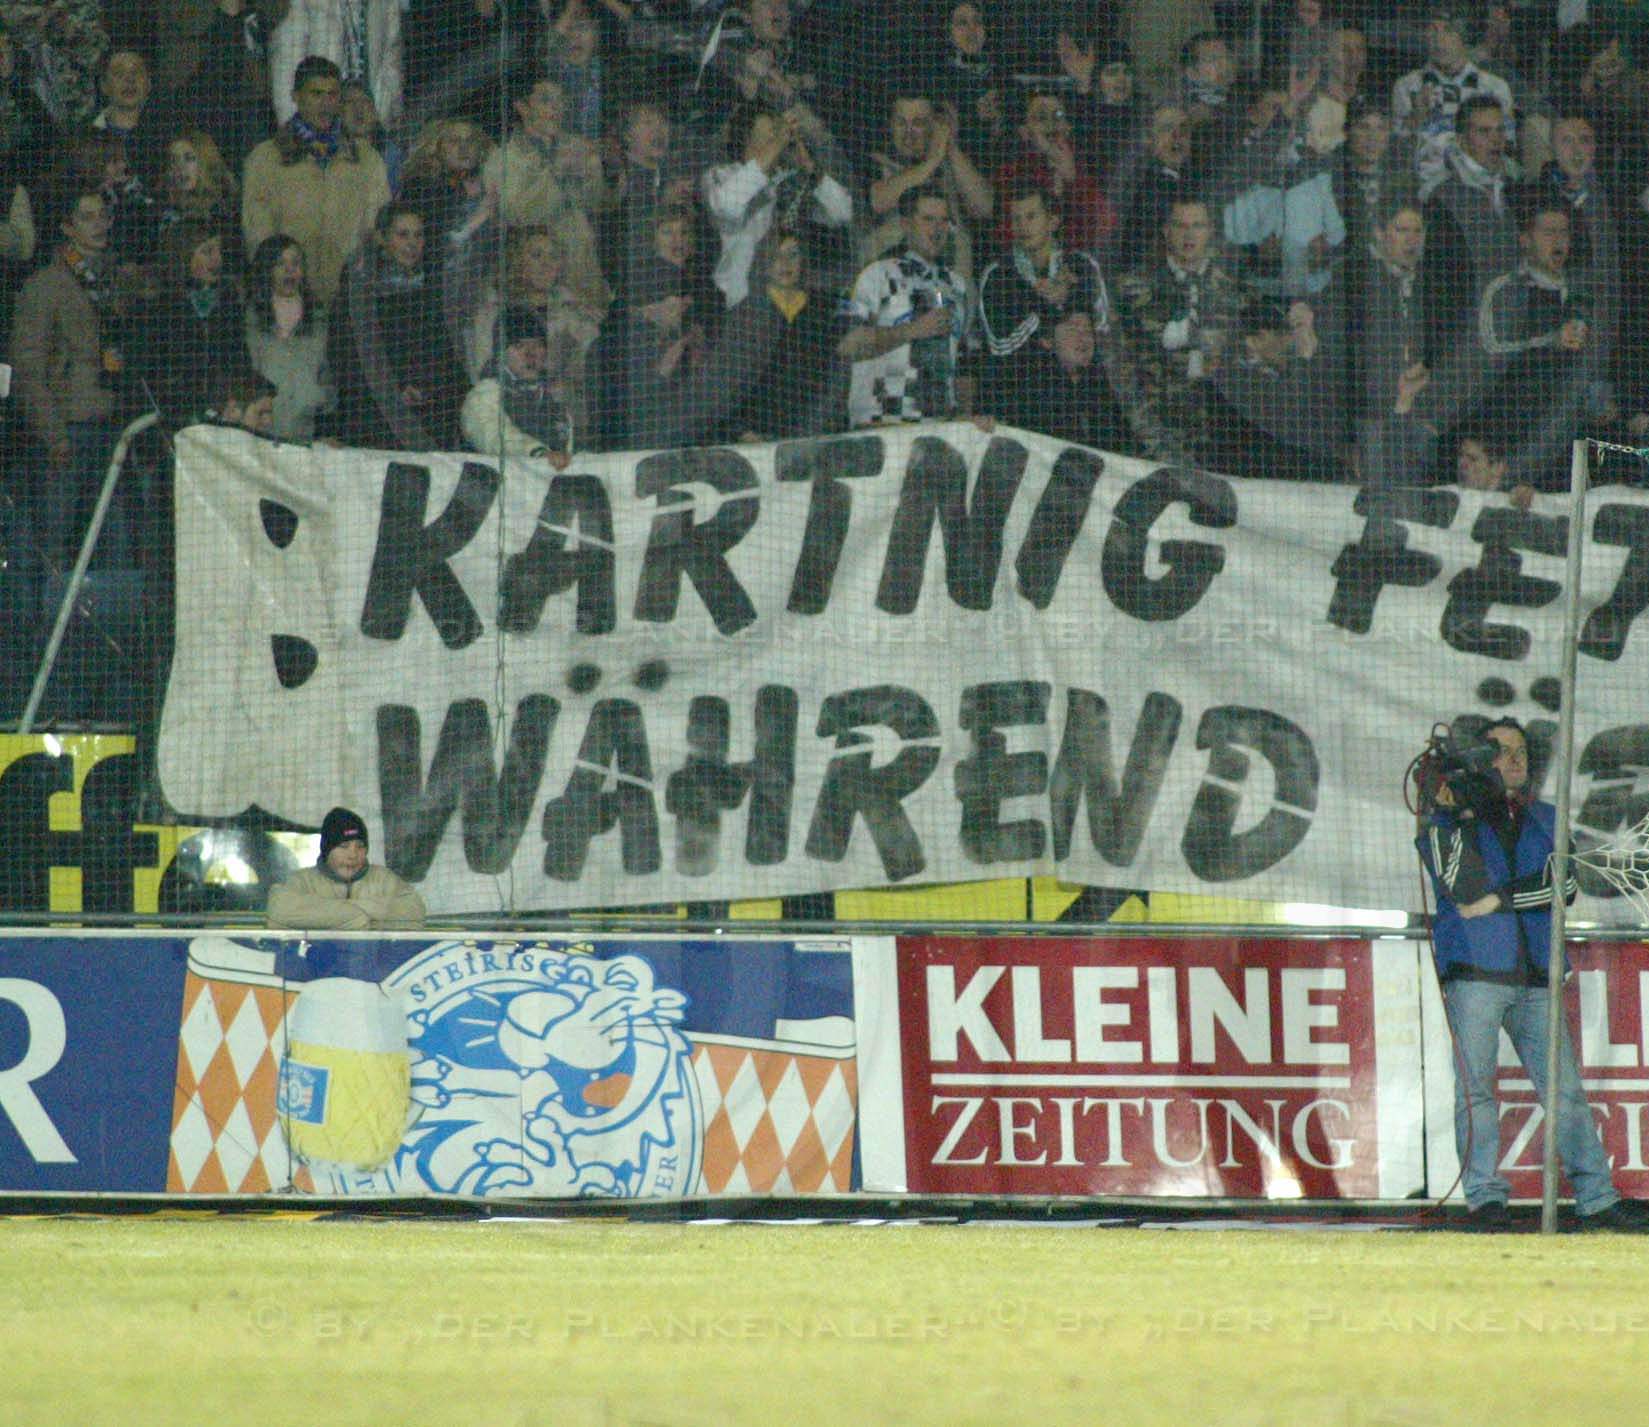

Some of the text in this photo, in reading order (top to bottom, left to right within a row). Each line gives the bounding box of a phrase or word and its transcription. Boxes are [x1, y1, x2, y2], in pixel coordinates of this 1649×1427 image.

[360, 435, 1238, 650] KARTNIG
[376, 659, 1320, 884] WÄHREND
[926, 964, 1350, 1067] KLEINE
[930, 1095, 1358, 1170] ZEITUNG
